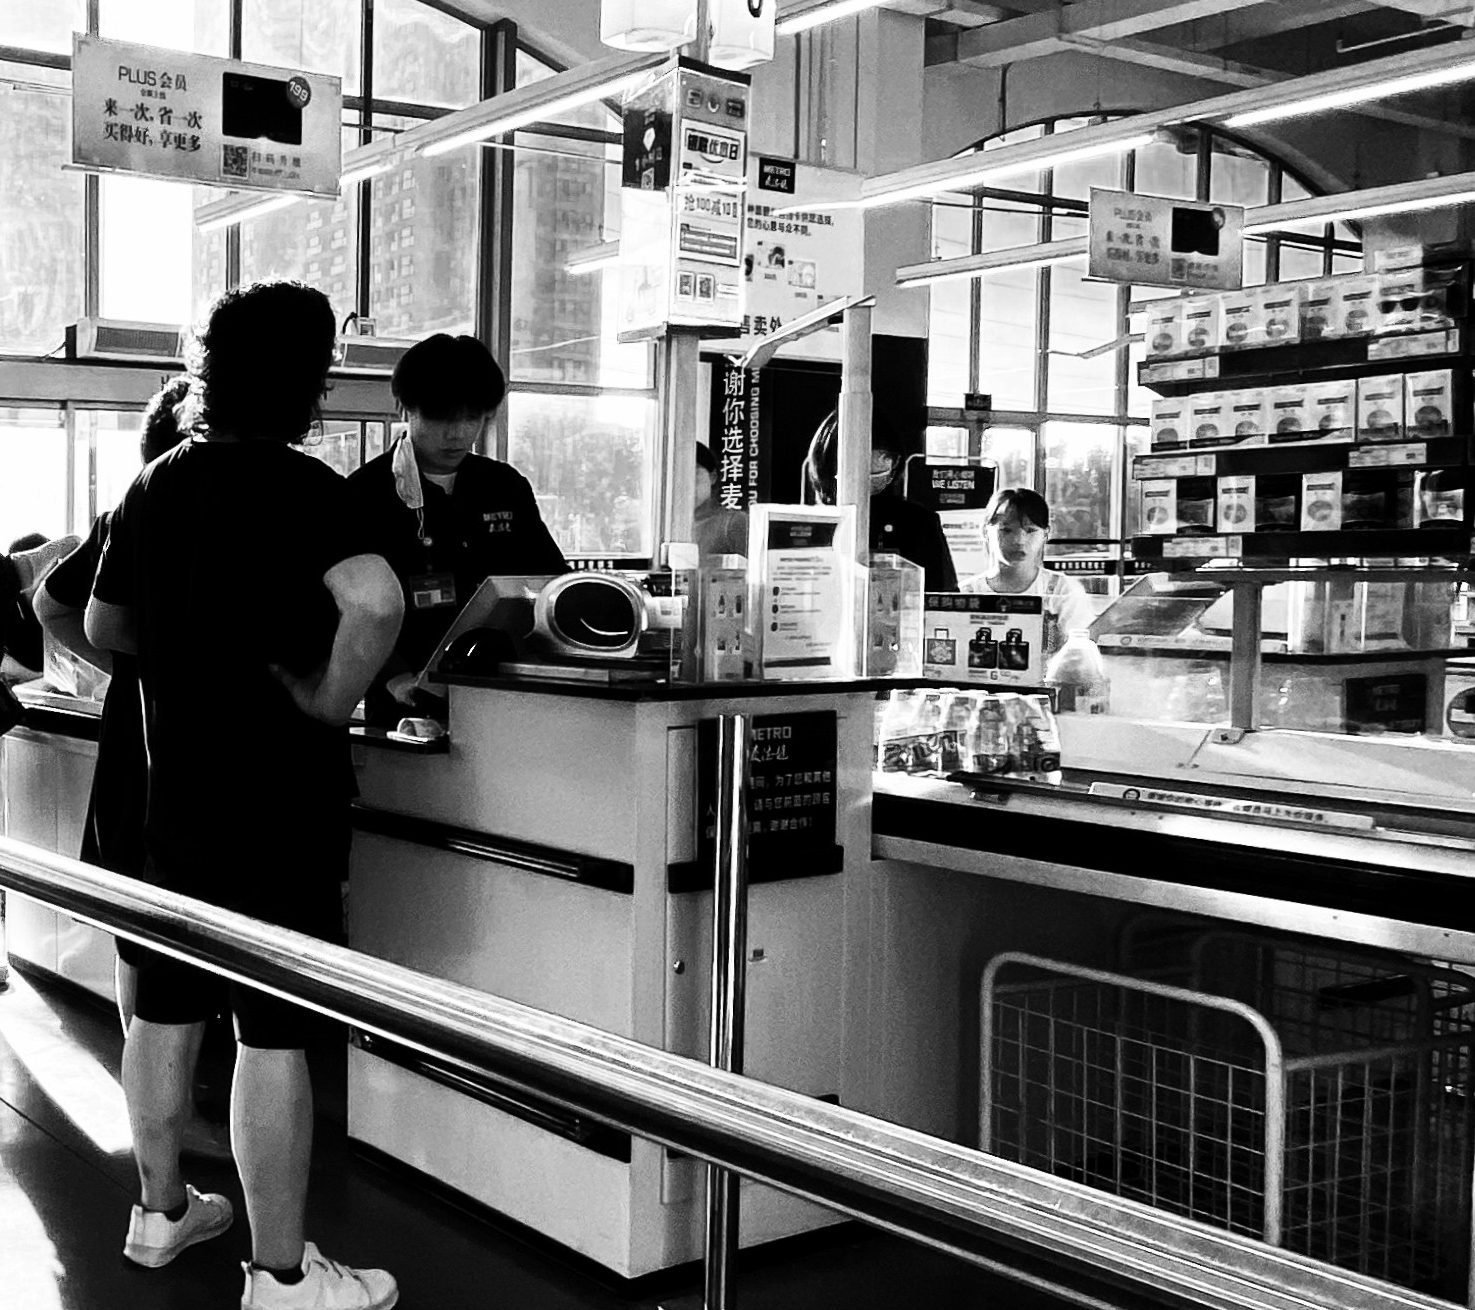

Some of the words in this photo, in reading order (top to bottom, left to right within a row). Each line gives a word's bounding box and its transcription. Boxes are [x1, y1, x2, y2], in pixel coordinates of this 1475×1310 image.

[118, 65, 157, 87] PLUS
[160, 71, 187, 91] 会员
[289, 82, 308, 101] 199
[720, 354, 746, 510] 谢你选择麦
